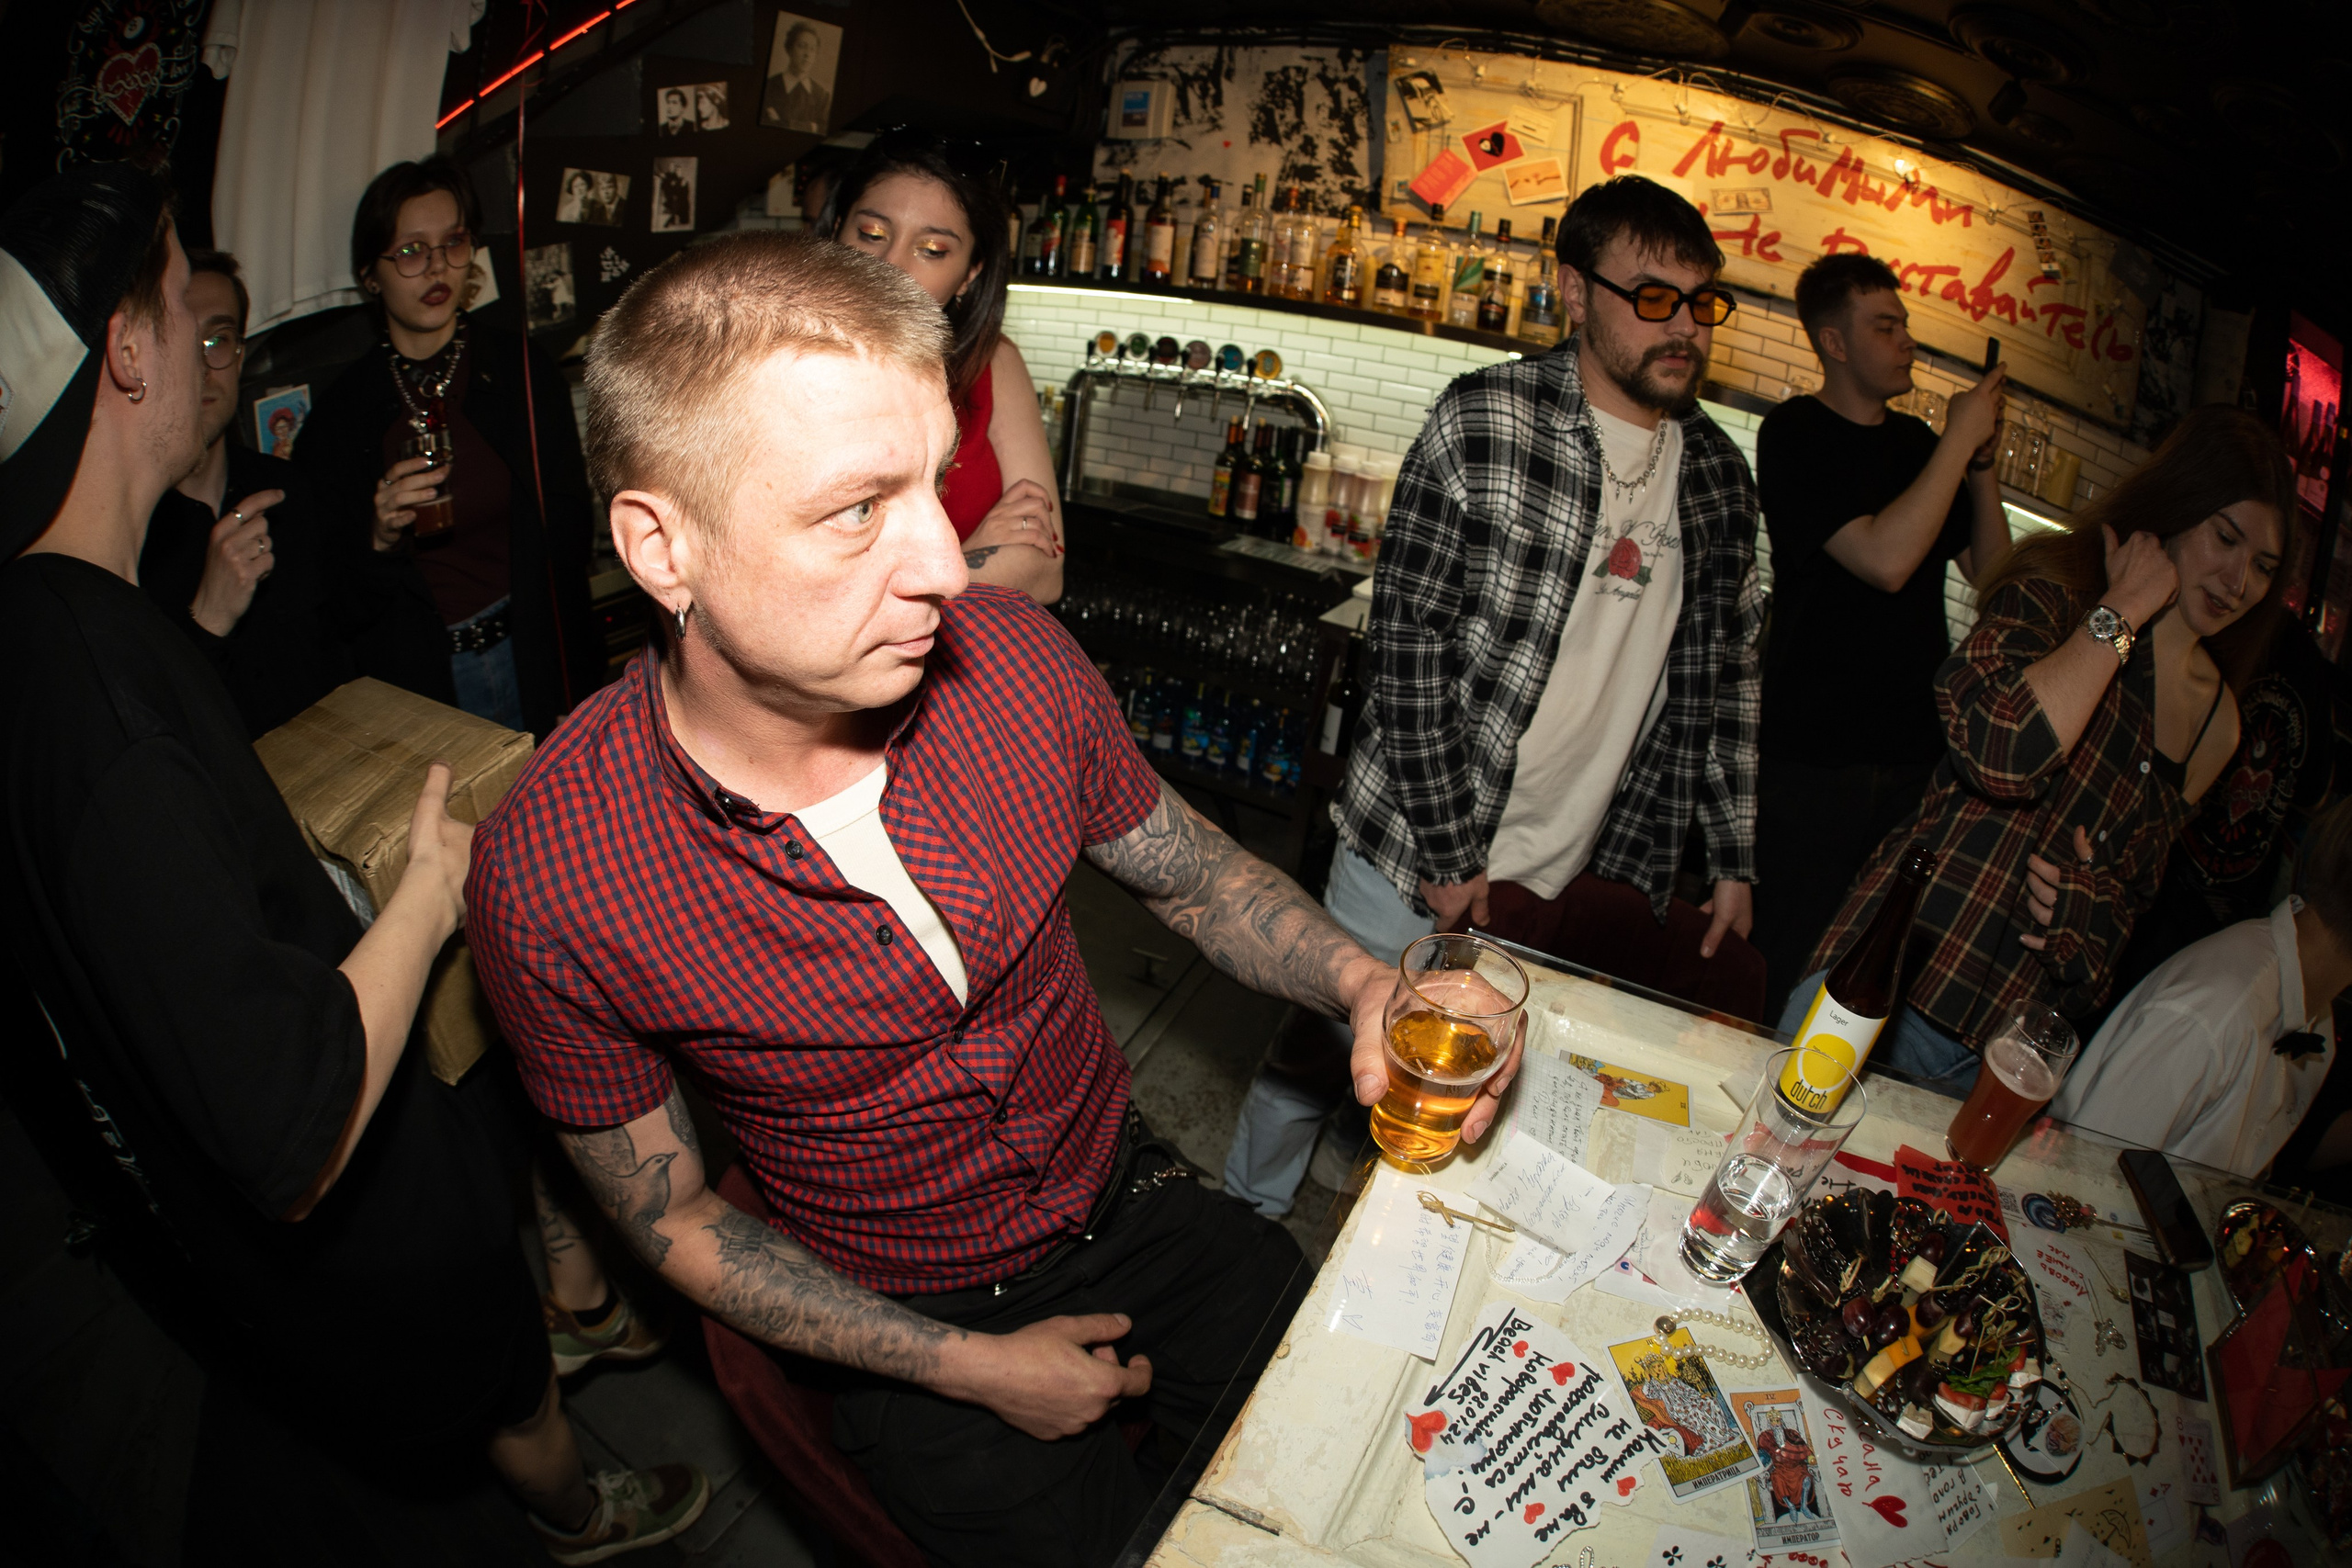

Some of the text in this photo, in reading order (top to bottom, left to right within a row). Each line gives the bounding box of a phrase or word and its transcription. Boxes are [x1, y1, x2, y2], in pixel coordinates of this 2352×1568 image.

[1600, 119, 1974, 228] С Любимыми
[1821, 227, 2134, 362] Рставайтесь
[1829, 1010, 1849, 1027] Lager
[1790, 1078, 1827, 1111] dutch
[1487, 1317, 1534, 1363] Beach
[1440, 1390, 1489, 1445] 08.01.24
[2176, 1416, 2184, 1431] 8
[1823, 1407, 1853, 1497] Скучаю
[1691, 1464, 1742, 1490] ИМПЕРАТРИЦА
[1933, 1481, 1955, 1504] голо
[1781, 1532, 1820, 1545] ИМПЕРАТОР
